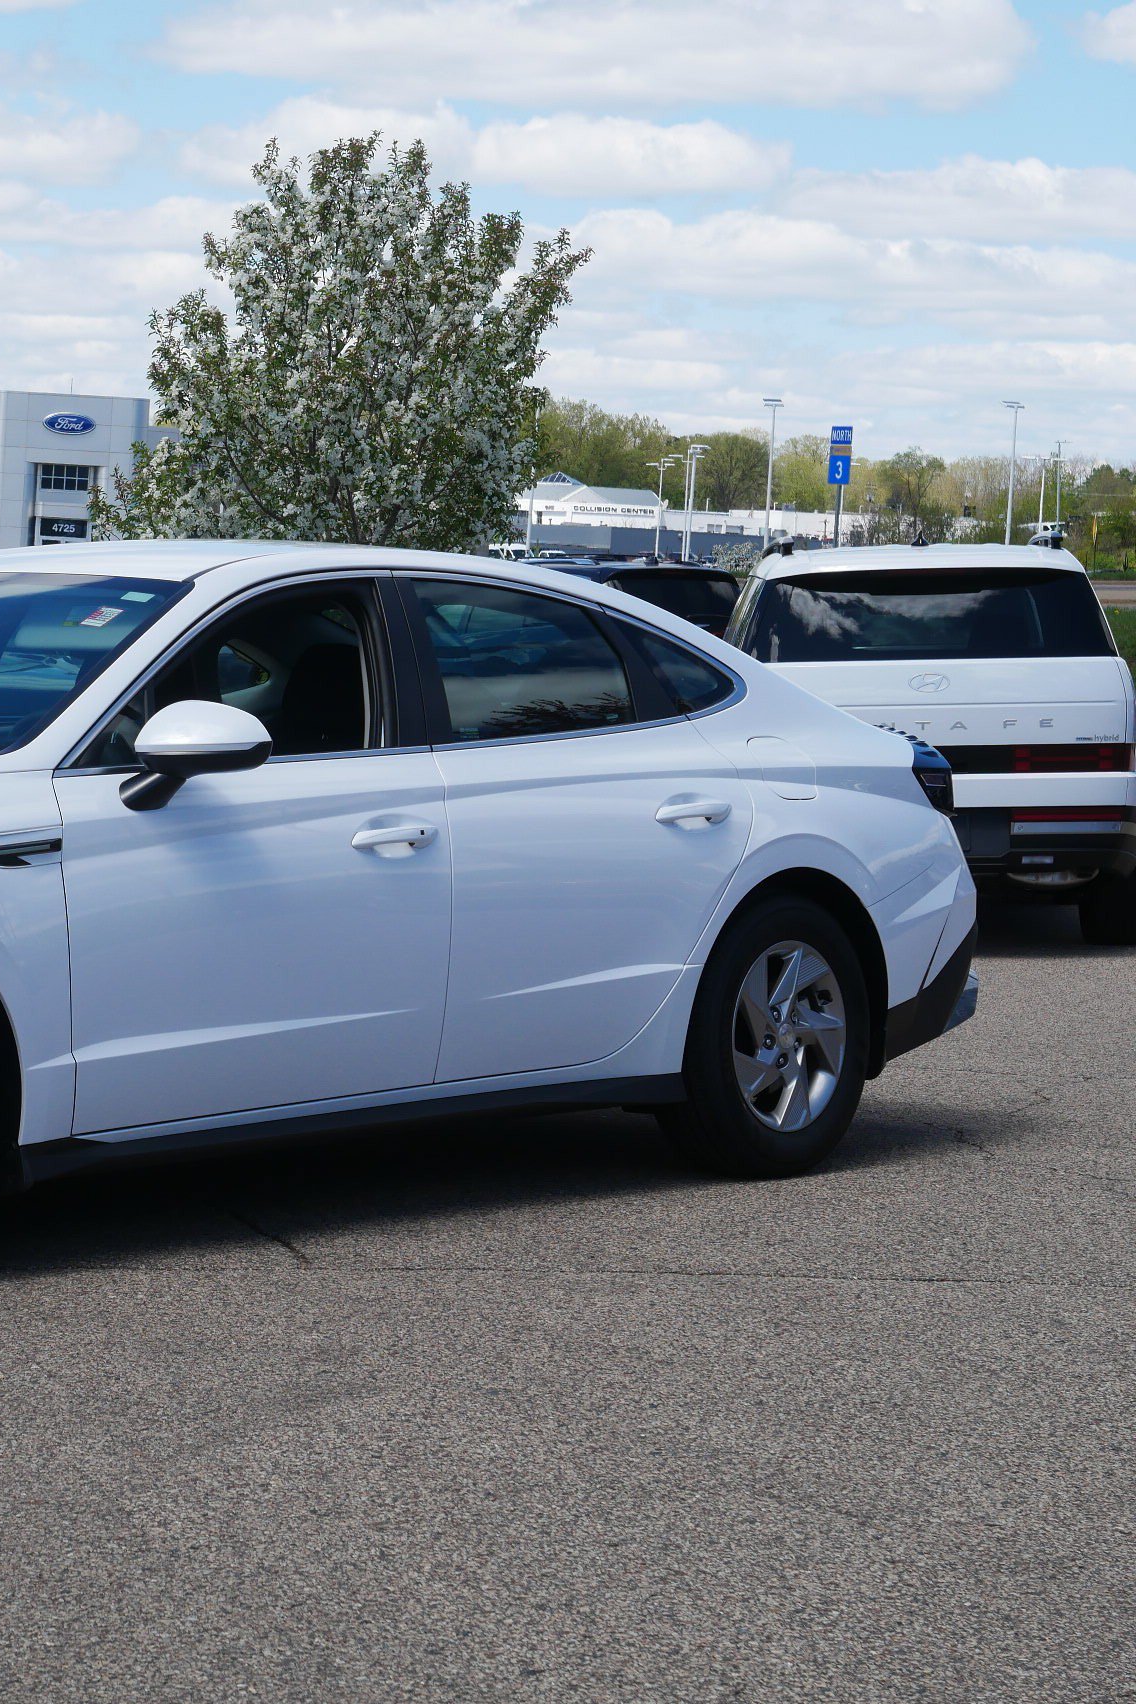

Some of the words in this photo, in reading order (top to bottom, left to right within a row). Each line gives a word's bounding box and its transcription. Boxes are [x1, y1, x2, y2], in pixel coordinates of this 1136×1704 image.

[54, 416, 85, 430] Ford
[831, 430, 852, 442] NORTH
[835, 461, 843, 479] 3
[573, 505, 618, 513] COLLISION
[621, 507, 655, 515] CENTER
[52, 523, 76, 533] 4725
[1094, 734, 1120, 742] hybrid
